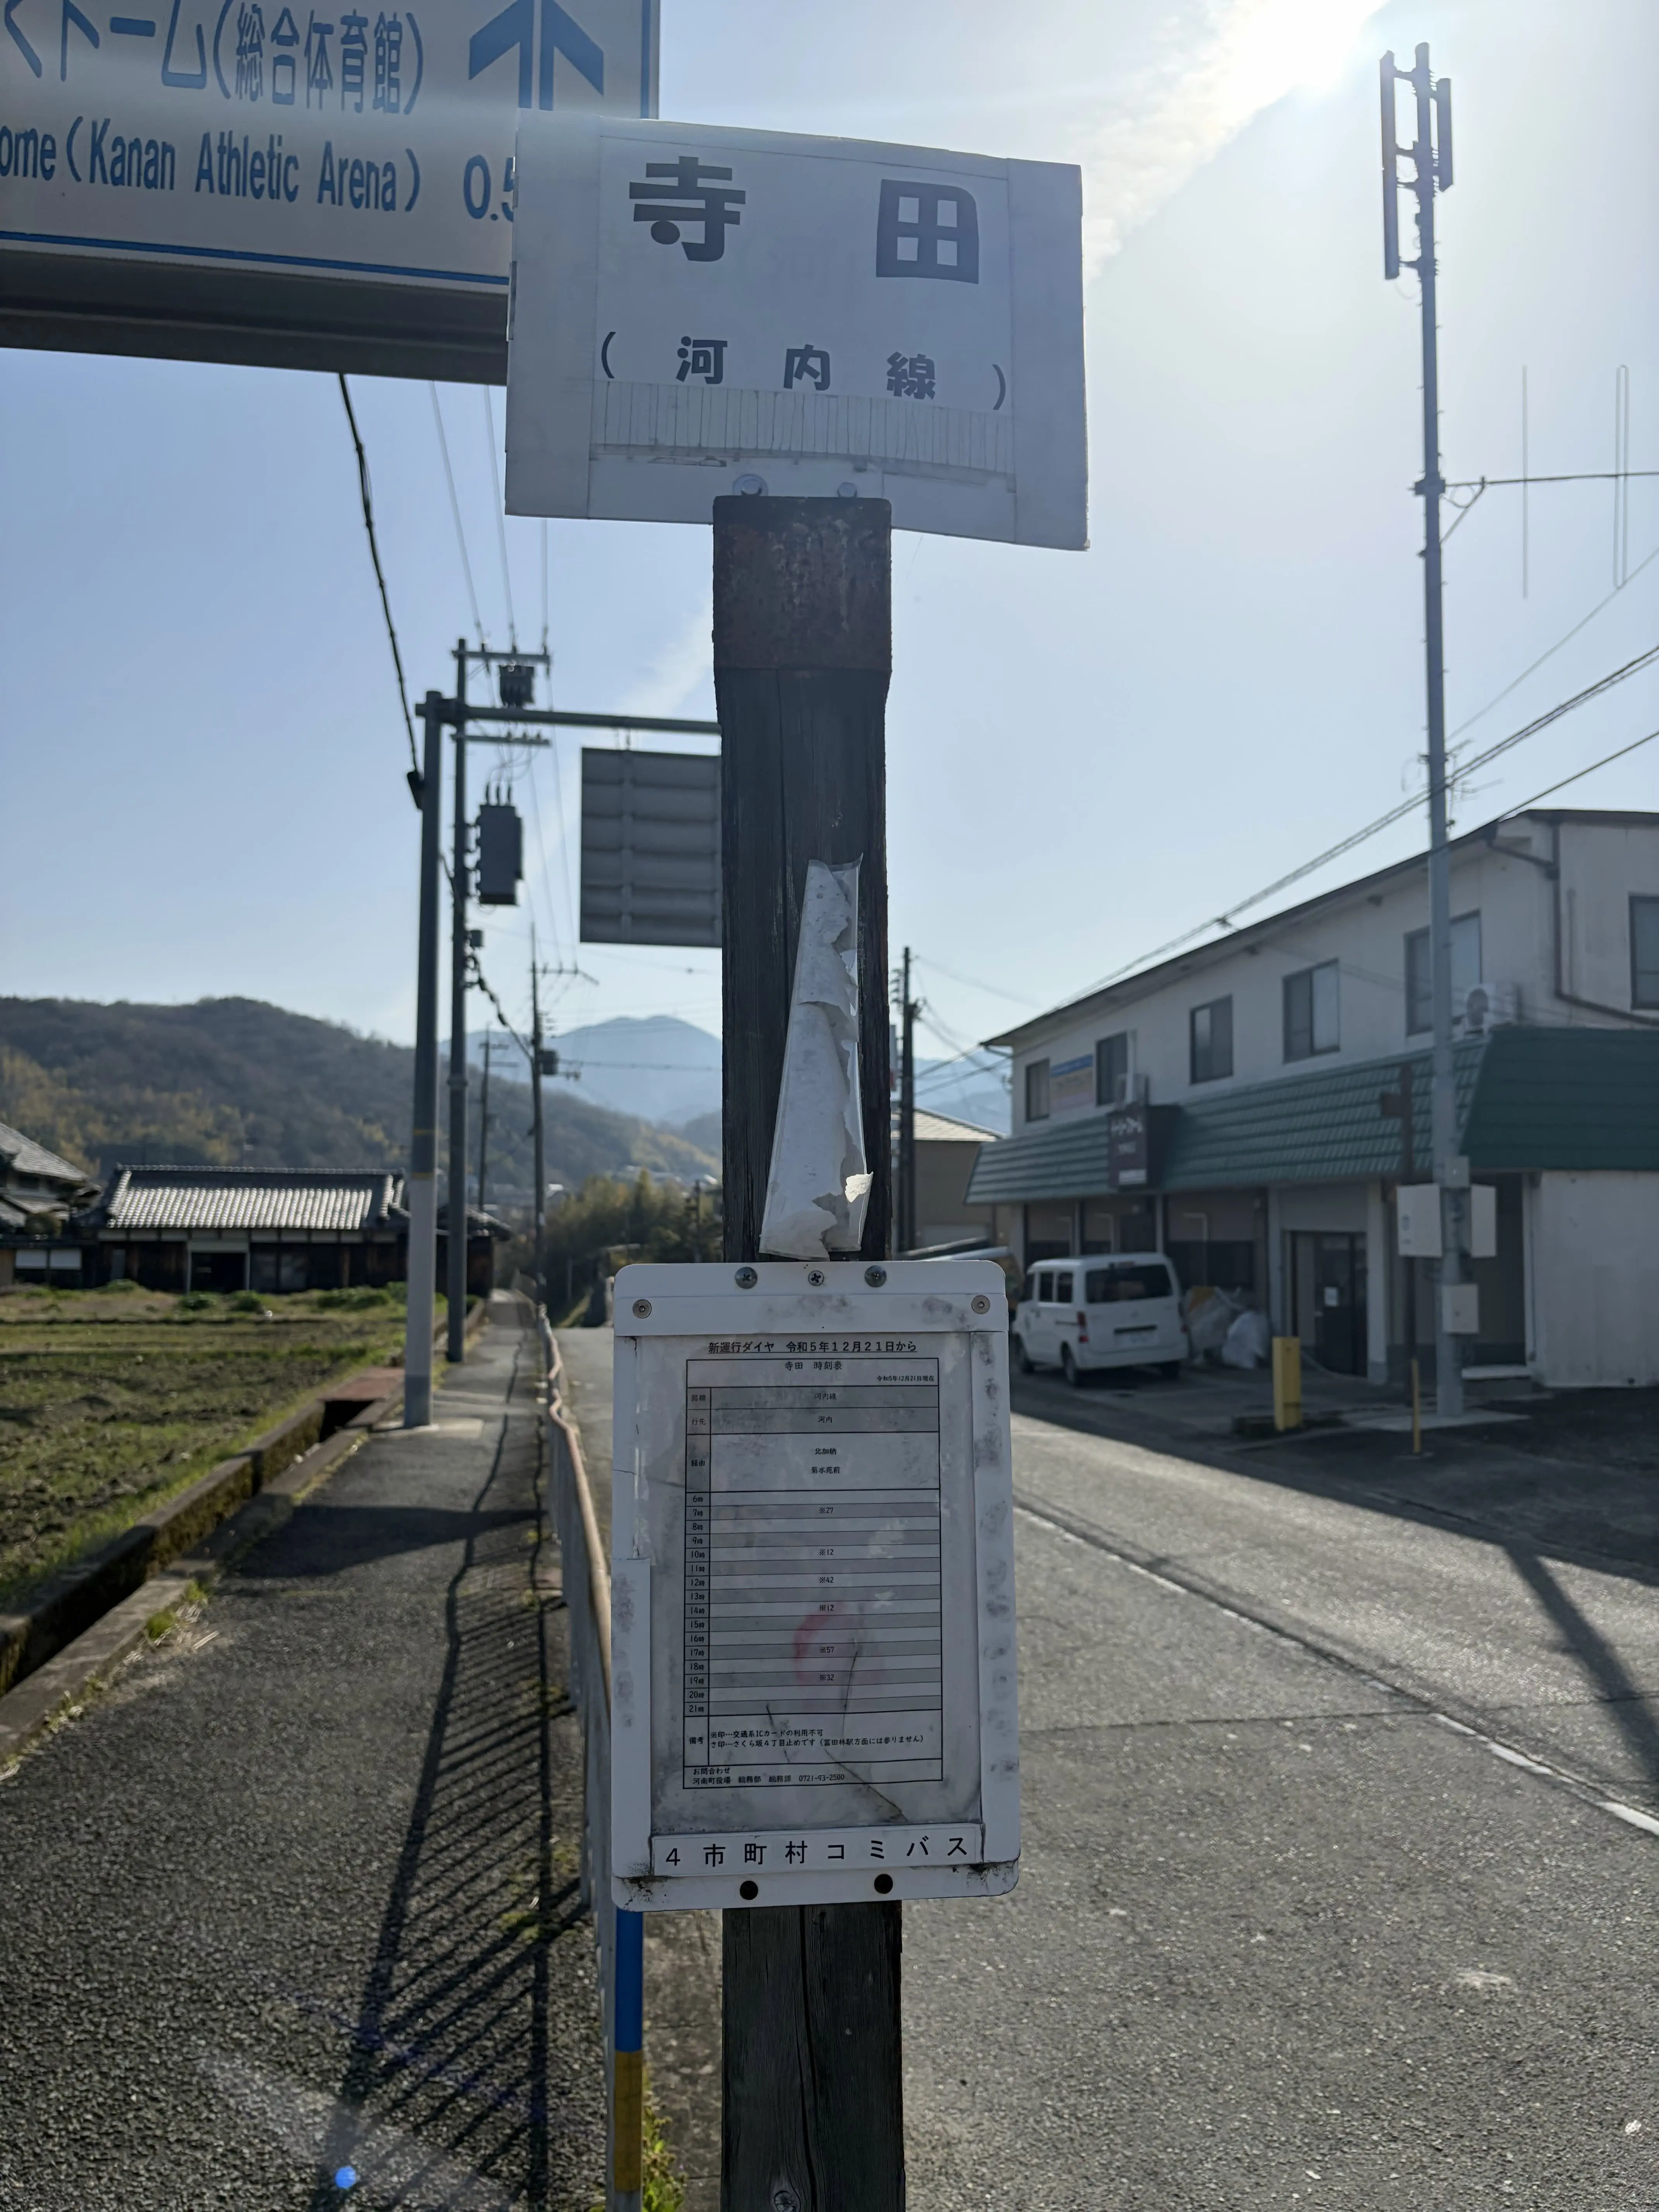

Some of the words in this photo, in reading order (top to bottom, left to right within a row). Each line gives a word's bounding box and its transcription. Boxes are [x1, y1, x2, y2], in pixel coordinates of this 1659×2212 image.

[194, 130, 299, 202] Athletic
[317, 140, 421, 212] Arena)
[629, 156, 980, 285] 寺田
[708, 1341, 776, 1353] 新運行ダイヤ
[784, 1361, 804, 1370] 寺田
[813, 1360, 842, 1370] 時刻表
[691, 1418, 706, 1426] 行先
[692, 1508, 703, 1517] 7時
[692, 1522, 703, 1531] 8時
[692, 1536, 703, 1545] 9時
[691, 1550, 705, 1559] 10時
[690, 1564, 705, 1572] 11時
[690, 1578, 705, 1587] 12時
[690, 1592, 705, 1601] 13時
[690, 1620, 704, 1628] 15時
[690, 1634, 704, 1642] 16時
[690, 1648, 704, 1657] 17時
[690, 1662, 704, 1671] 18時
[690, 1677, 704, 1685] 19時
[689, 1691, 704, 1699] 20時
[689, 1705, 704, 1713] 21時
[692, 1767, 730, 1775] お問合わせ
[799, 1773, 845, 1782] 0721-93-2500
